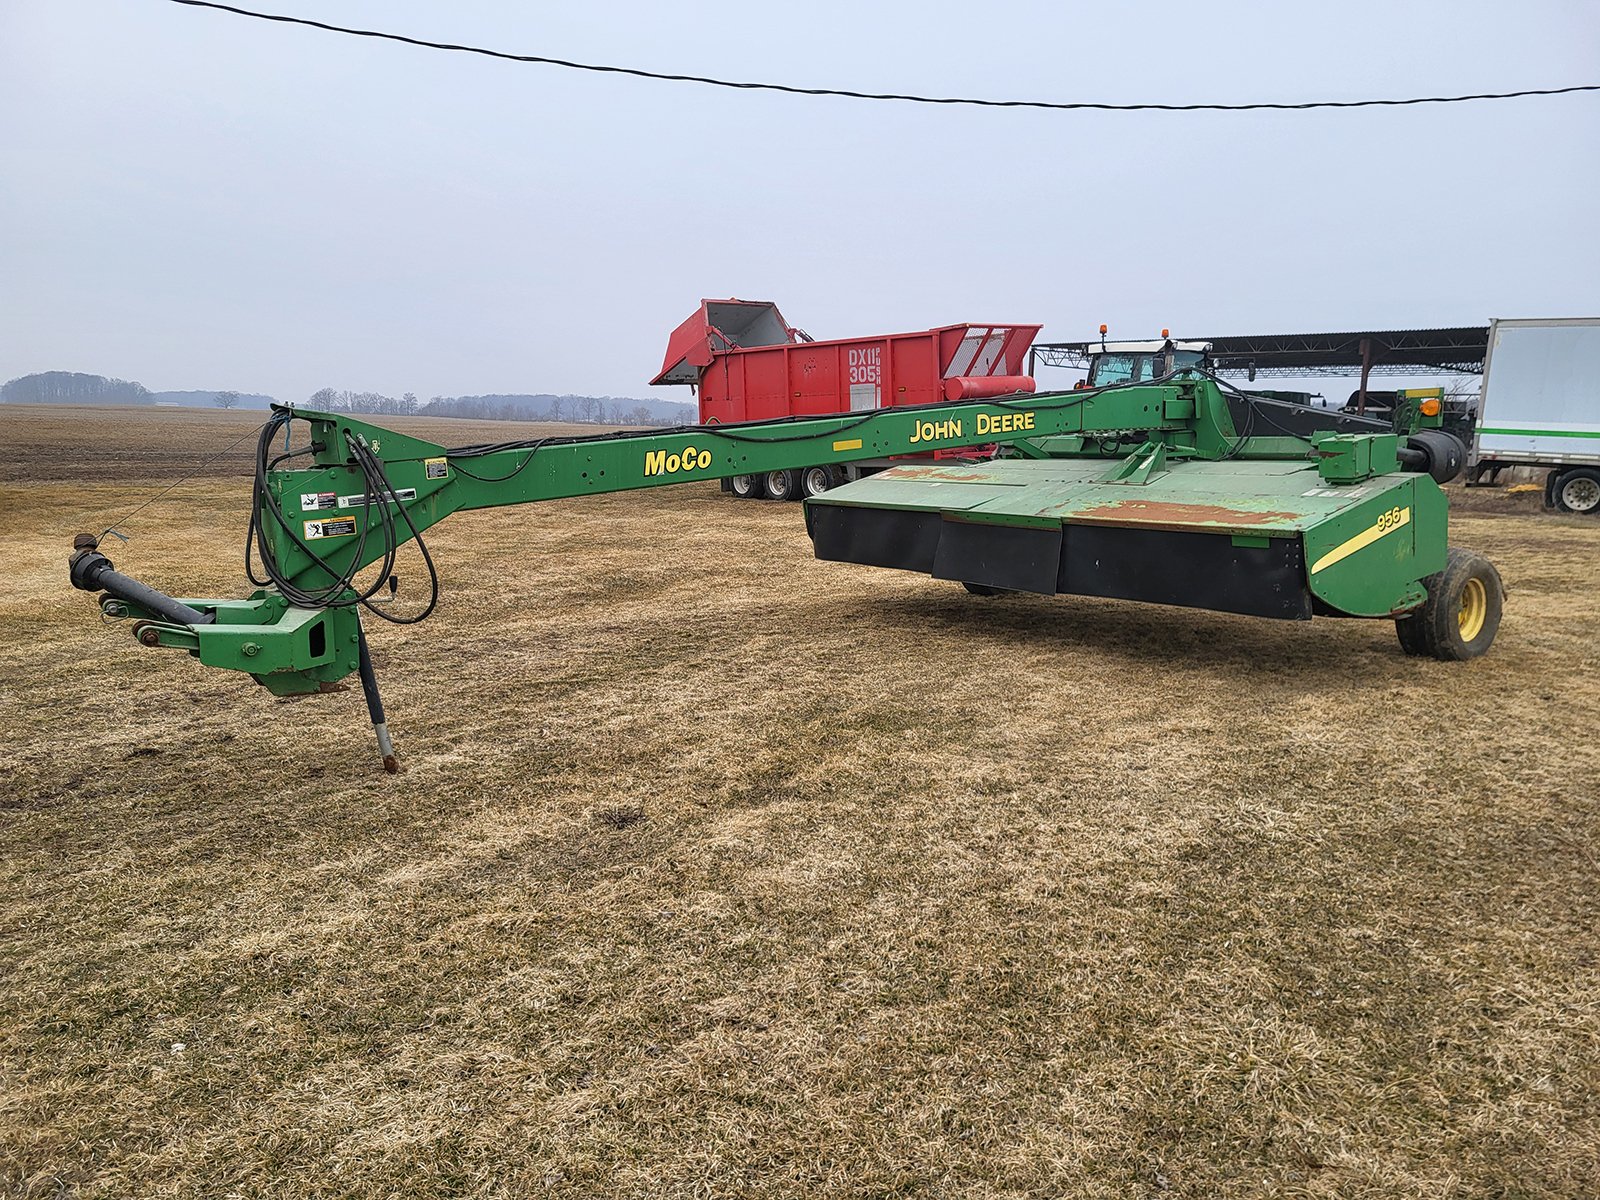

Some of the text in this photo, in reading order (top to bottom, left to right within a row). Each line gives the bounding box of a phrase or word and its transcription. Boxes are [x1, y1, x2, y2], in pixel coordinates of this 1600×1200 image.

[849, 348, 875, 366] DX11
[849, 365, 876, 383] 305
[909, 412, 1035, 443] JOHN DEERE
[644, 446, 712, 476] MoCo
[1377, 506, 1401, 532] 956
